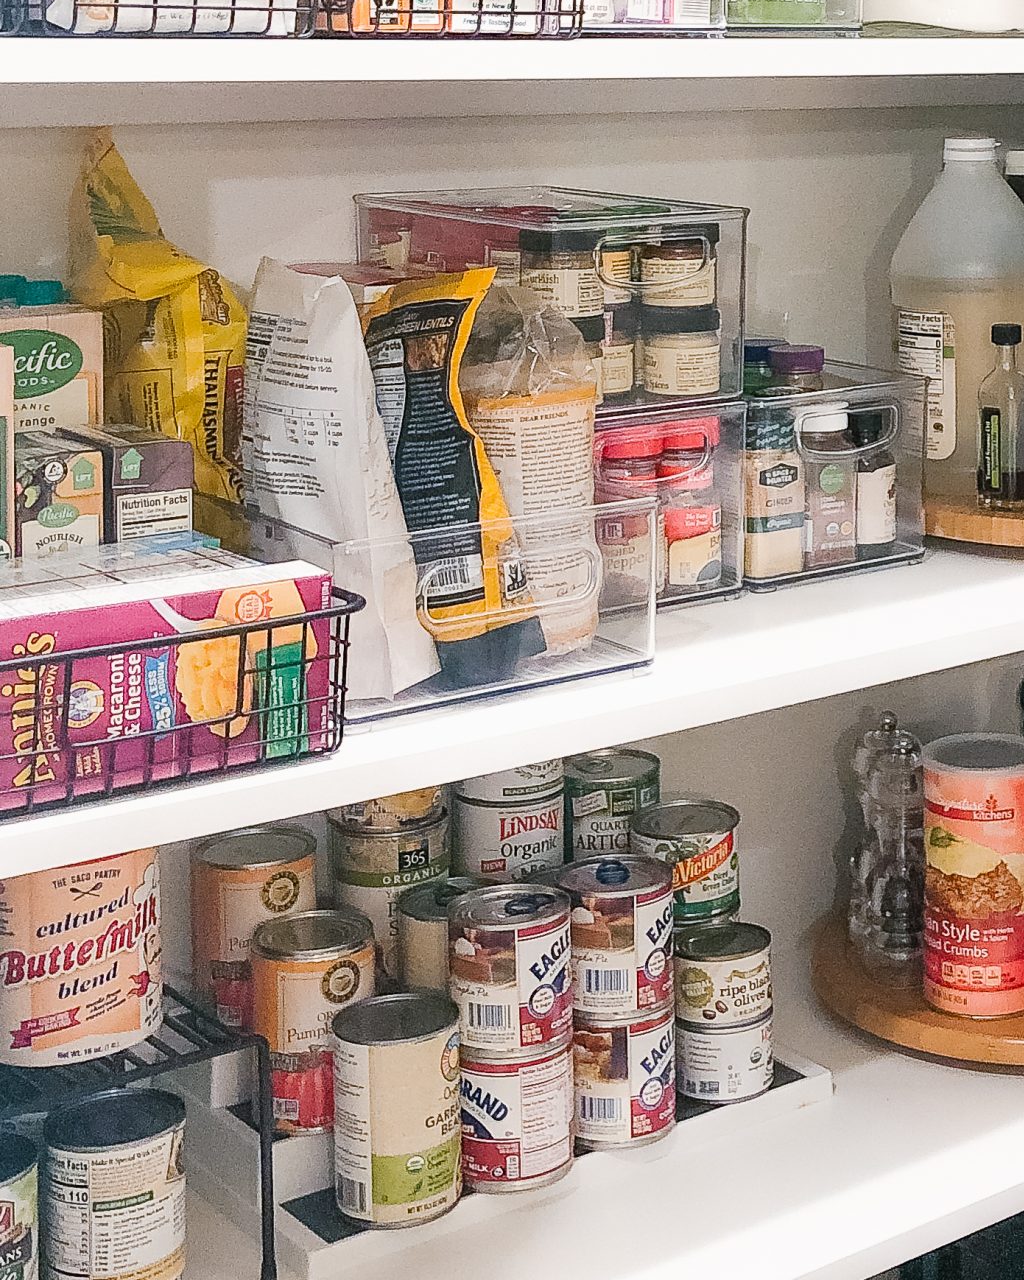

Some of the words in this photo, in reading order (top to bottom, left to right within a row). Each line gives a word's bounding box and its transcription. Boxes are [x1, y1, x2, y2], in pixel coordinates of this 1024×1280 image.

[922, 313, 941, 323] Facts
[14, 341, 73, 374] cific
[19, 416, 56, 428] range
[121, 497, 162, 512] Nutrition
[163, 494, 188, 506] Facts
[35, 531, 84, 549] NOURISH
[107, 653, 124, 739] Macaroni
[125, 653, 142, 722] Cheese
[500, 835, 558, 860] Organic
[402, 850, 426, 868] 365
[677, 841, 730, 883] Victoria
[52, 878, 67, 889] THE
[94, 868, 121, 880] PANTRY
[382, 865, 441, 885] ORGANIC
[36, 886, 131, 939] cultured
[1, 893, 157, 987] Buttermilk
[942, 920, 980, 943] Style
[943, 940, 988, 959] Crumbs
[58, 960, 119, 1001] blend
[719, 982, 747, 1000] ripe
[733, 988, 766, 1008] olives
[286, 1022, 333, 1043] Pumpk
[66, 1159, 88, 1171] Facts
[69, 1190, 88, 1203] 110
